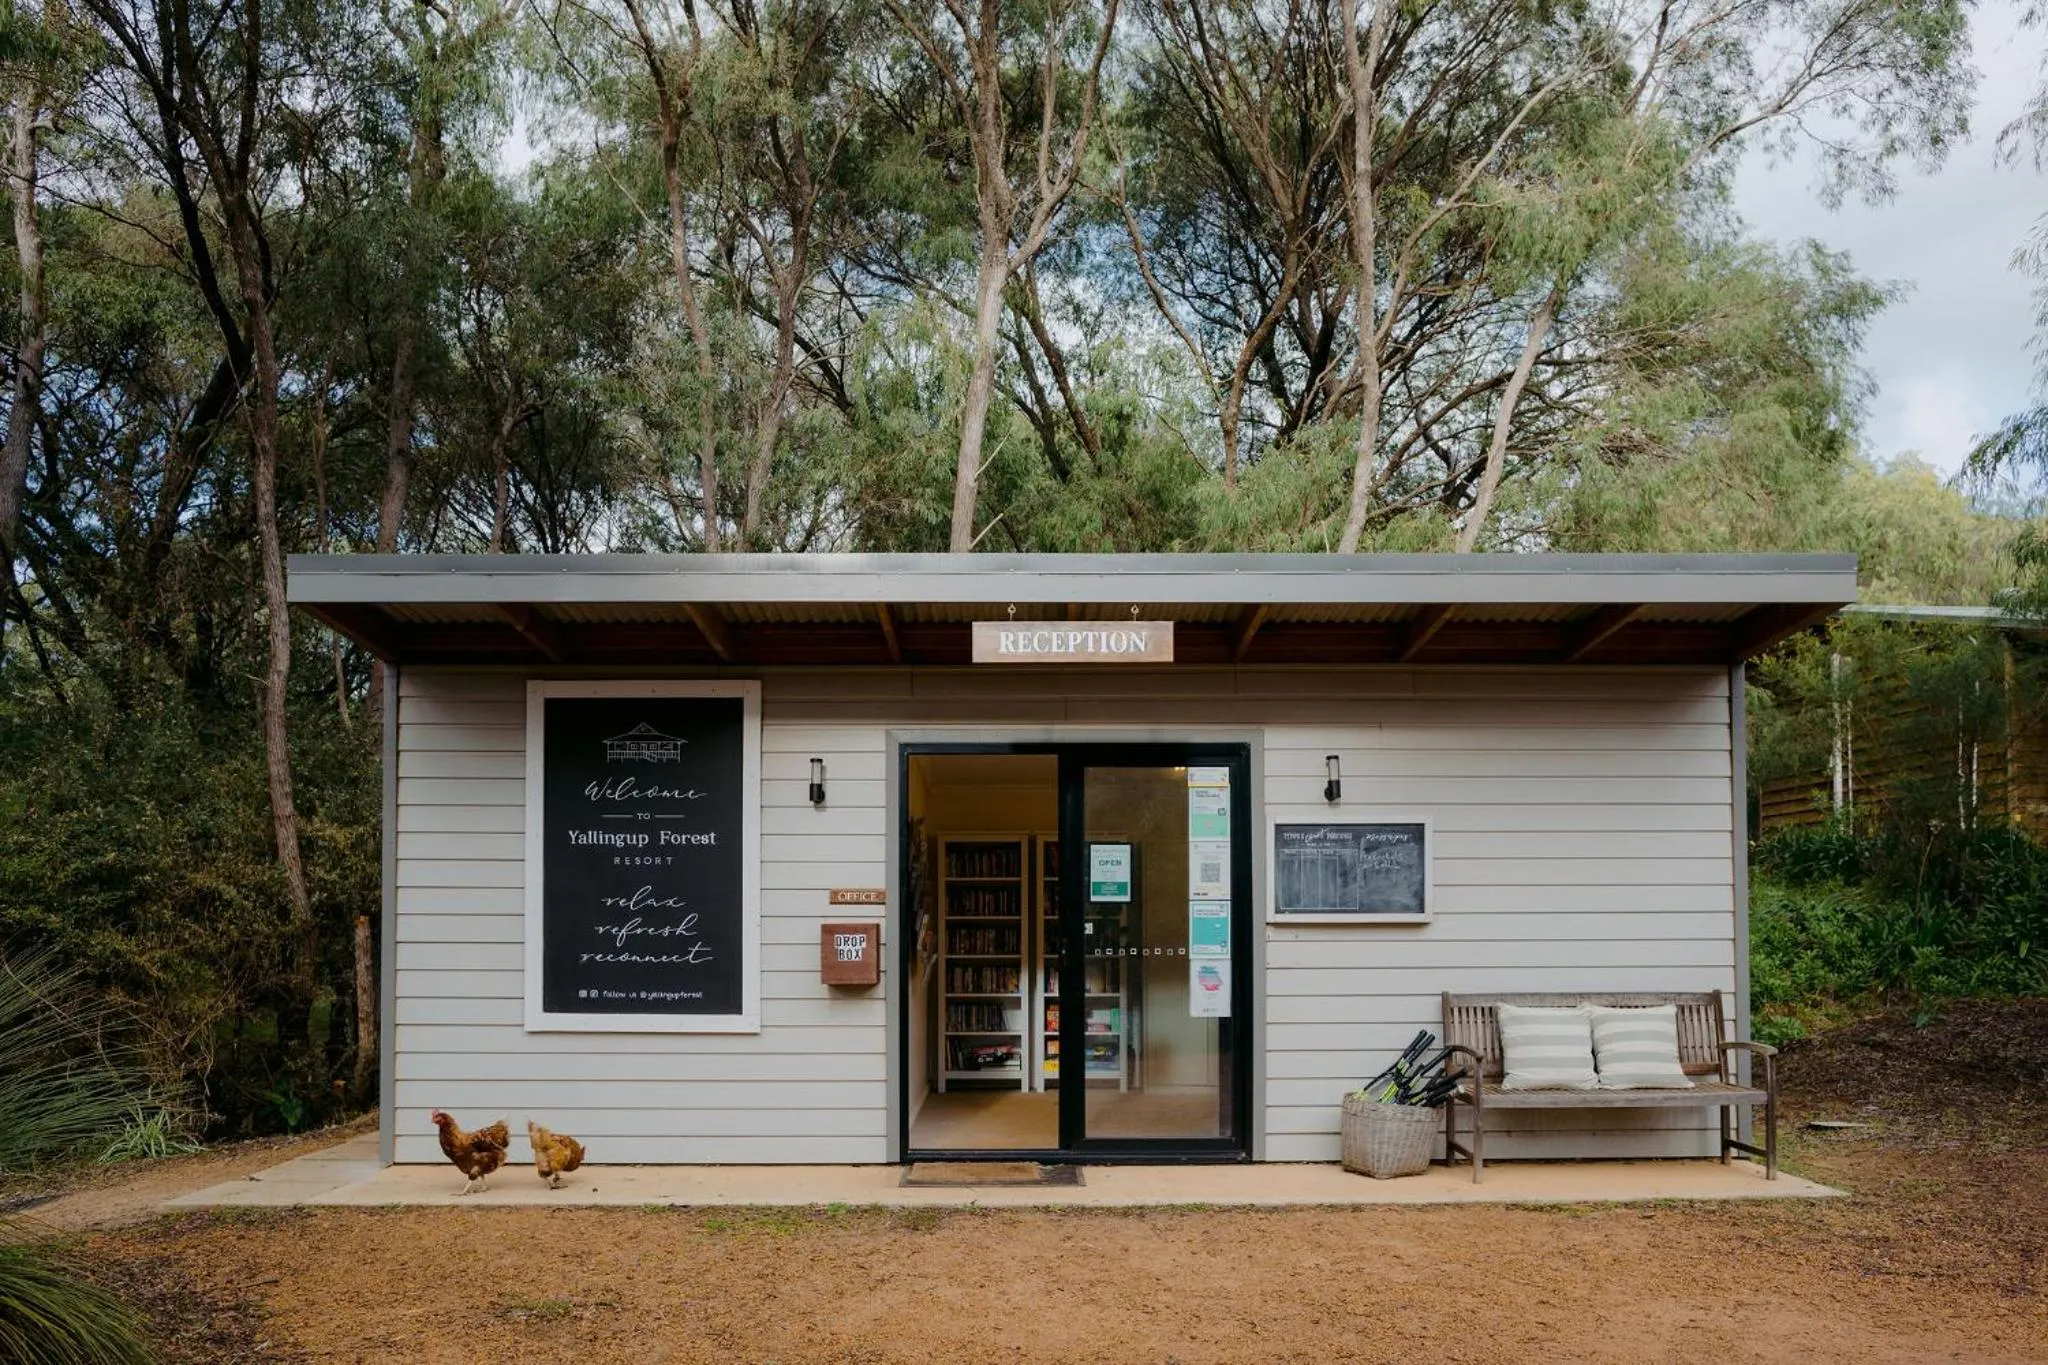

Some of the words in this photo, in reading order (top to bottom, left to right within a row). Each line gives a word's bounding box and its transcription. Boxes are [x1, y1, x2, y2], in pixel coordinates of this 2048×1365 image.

[998, 631, 1147, 653] RECEPTION
[585, 777, 708, 801] Welcome
[637, 812, 651, 820] TO
[568, 830, 650, 847] Yallingup
[660, 830, 717, 845] Forest
[614, 857, 674, 865] RESORT
[601, 885, 687, 911] relax
[838, 892, 877, 901] OFFICE
[594, 913, 699, 947] refresh
[836, 936, 865, 947] DROP
[579, 942, 714, 963] reconnect
[839, 949, 861, 960] BOX
